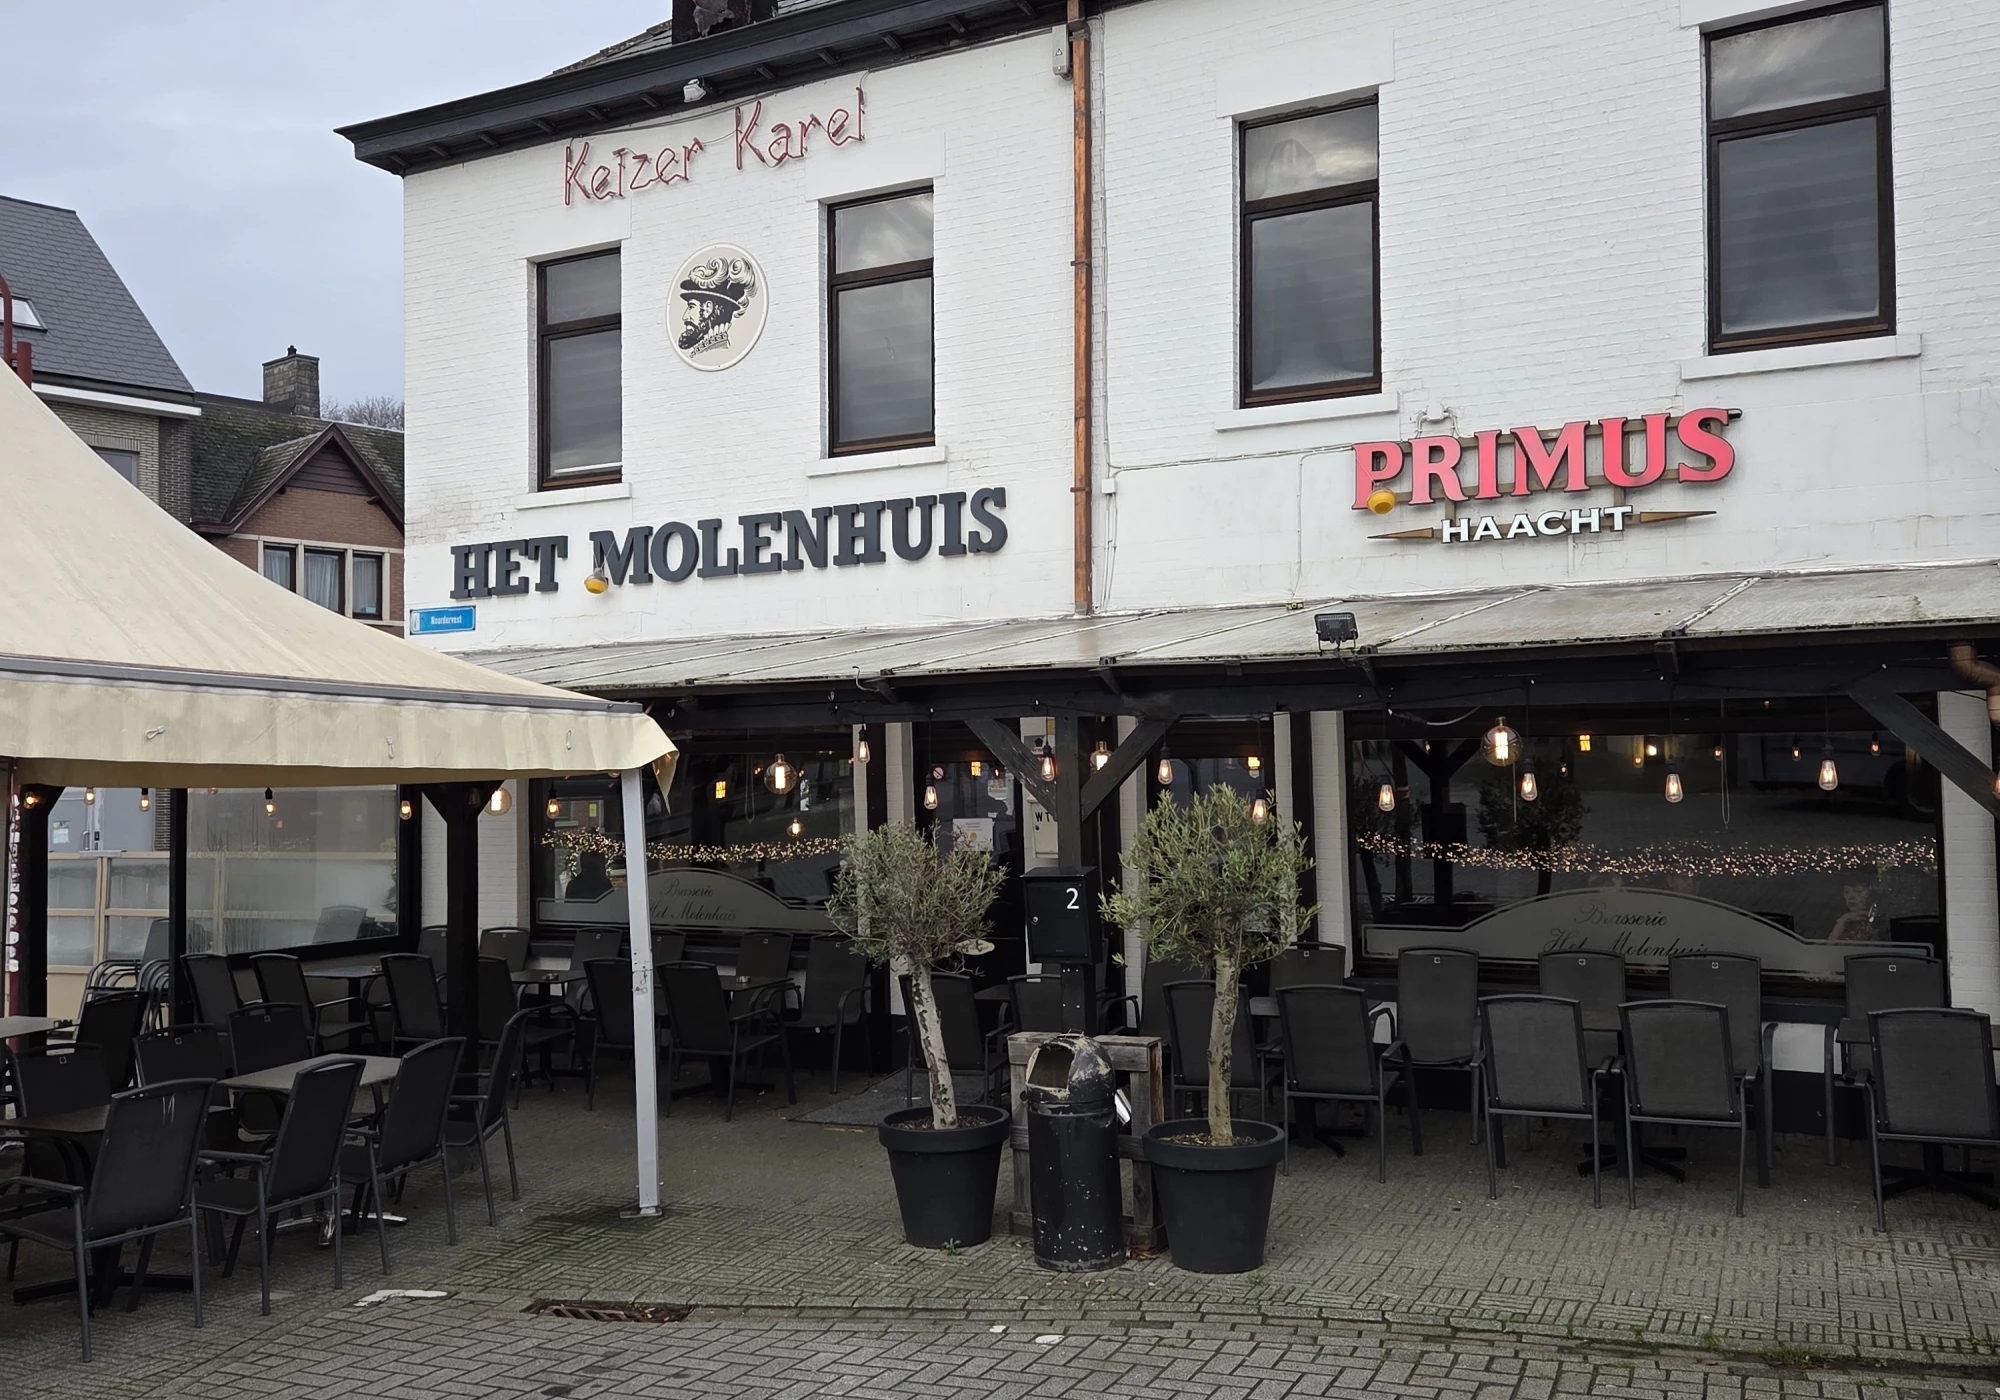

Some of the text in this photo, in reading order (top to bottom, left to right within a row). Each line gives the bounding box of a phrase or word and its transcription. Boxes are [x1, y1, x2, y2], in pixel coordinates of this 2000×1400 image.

[564, 86, 866, 206] Keizer Karel
[1351, 407, 1735, 509] PRIMUS
[450, 487, 1009, 600] HET MOLENHUIS
[1441, 505, 1633, 544] HAACHT
[430, 616, 462, 625] Noordervest
[661, 879, 714, 897] Brasserie
[1066, 887, 1080, 910] 2
